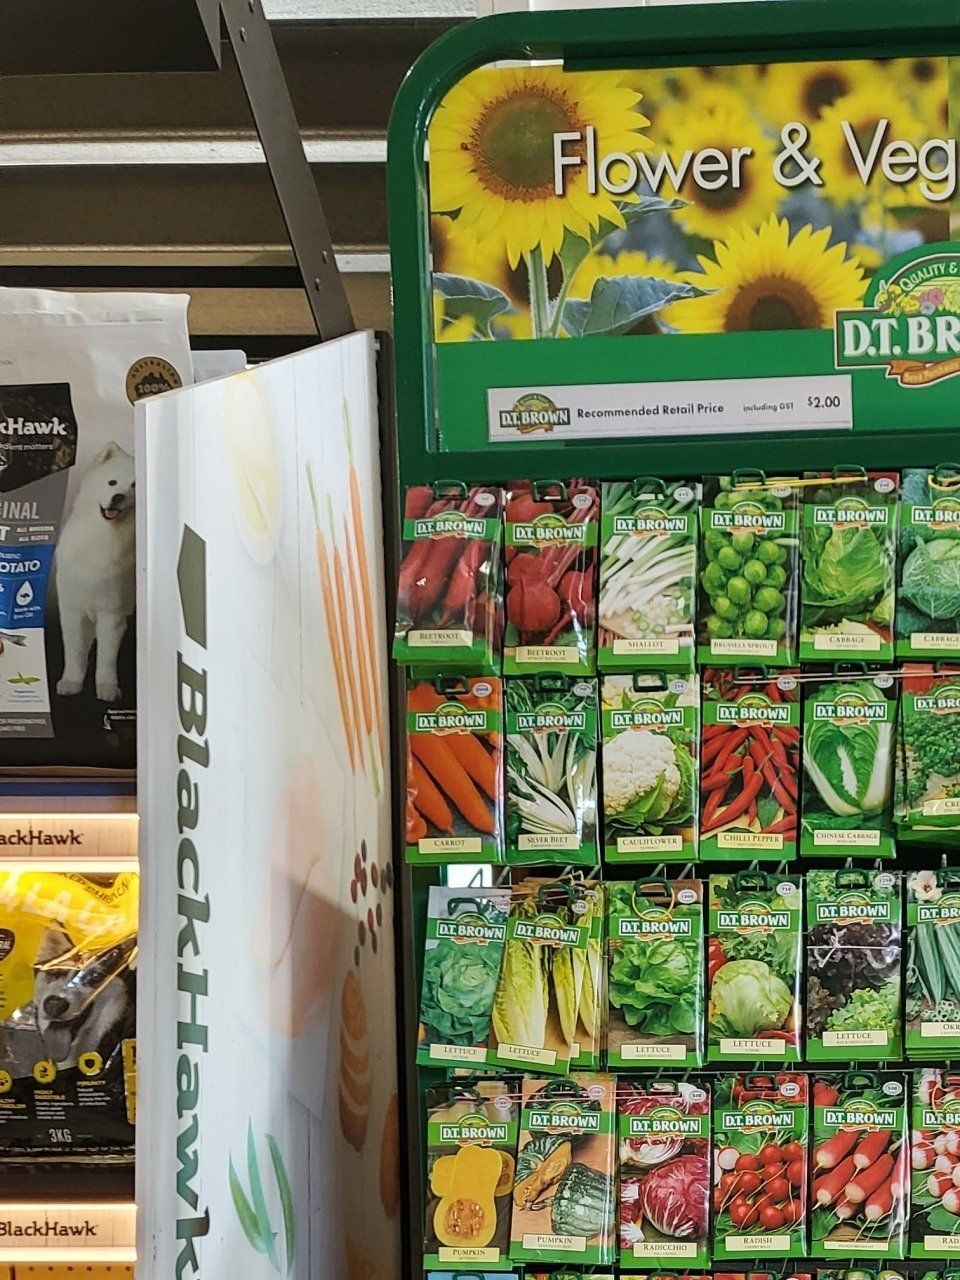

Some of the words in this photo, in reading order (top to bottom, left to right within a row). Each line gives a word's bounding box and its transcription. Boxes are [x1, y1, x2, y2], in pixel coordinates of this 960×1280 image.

[553, 126, 753, 195] Flower
[773, 121, 823, 187] &
[949, 261, 958, 273] &
[843, 318, 902, 357] D.T.
[577, 406, 660, 418] Recommended
[662, 404, 694, 416] Retail
[698, 403, 725, 414] Price
[743, 403, 778, 412] including
[779, 402, 794, 411] GST
[807, 396, 841, 408] $2.00
[525, 411, 568, 424] BROWN
[837, 509, 885, 521] BROWN
[436, 522, 483, 534] BROWN
[438, 714, 485, 727] BROWN
[634, 712, 681, 727] BROWN
[641, 919, 689, 932] BROWN
[836, 1032, 872, 1040] LETTUCE
[635, 1046, 671, 1054] LETTUCE
[732, 1040, 772, 1048] LETTUCE
[744, 1113, 792, 1126] BROWN
[49, 1128, 72, 1143] 3KG
[461, 1127, 505, 1139] BROWN
[537, 1236, 573, 1244] PUMPKIN
[743, 1236, 772, 1244] RADISH
[453, 1249, 486, 1257] PUMPKIN
[643, 1243, 688, 1251] RADICCHIO
